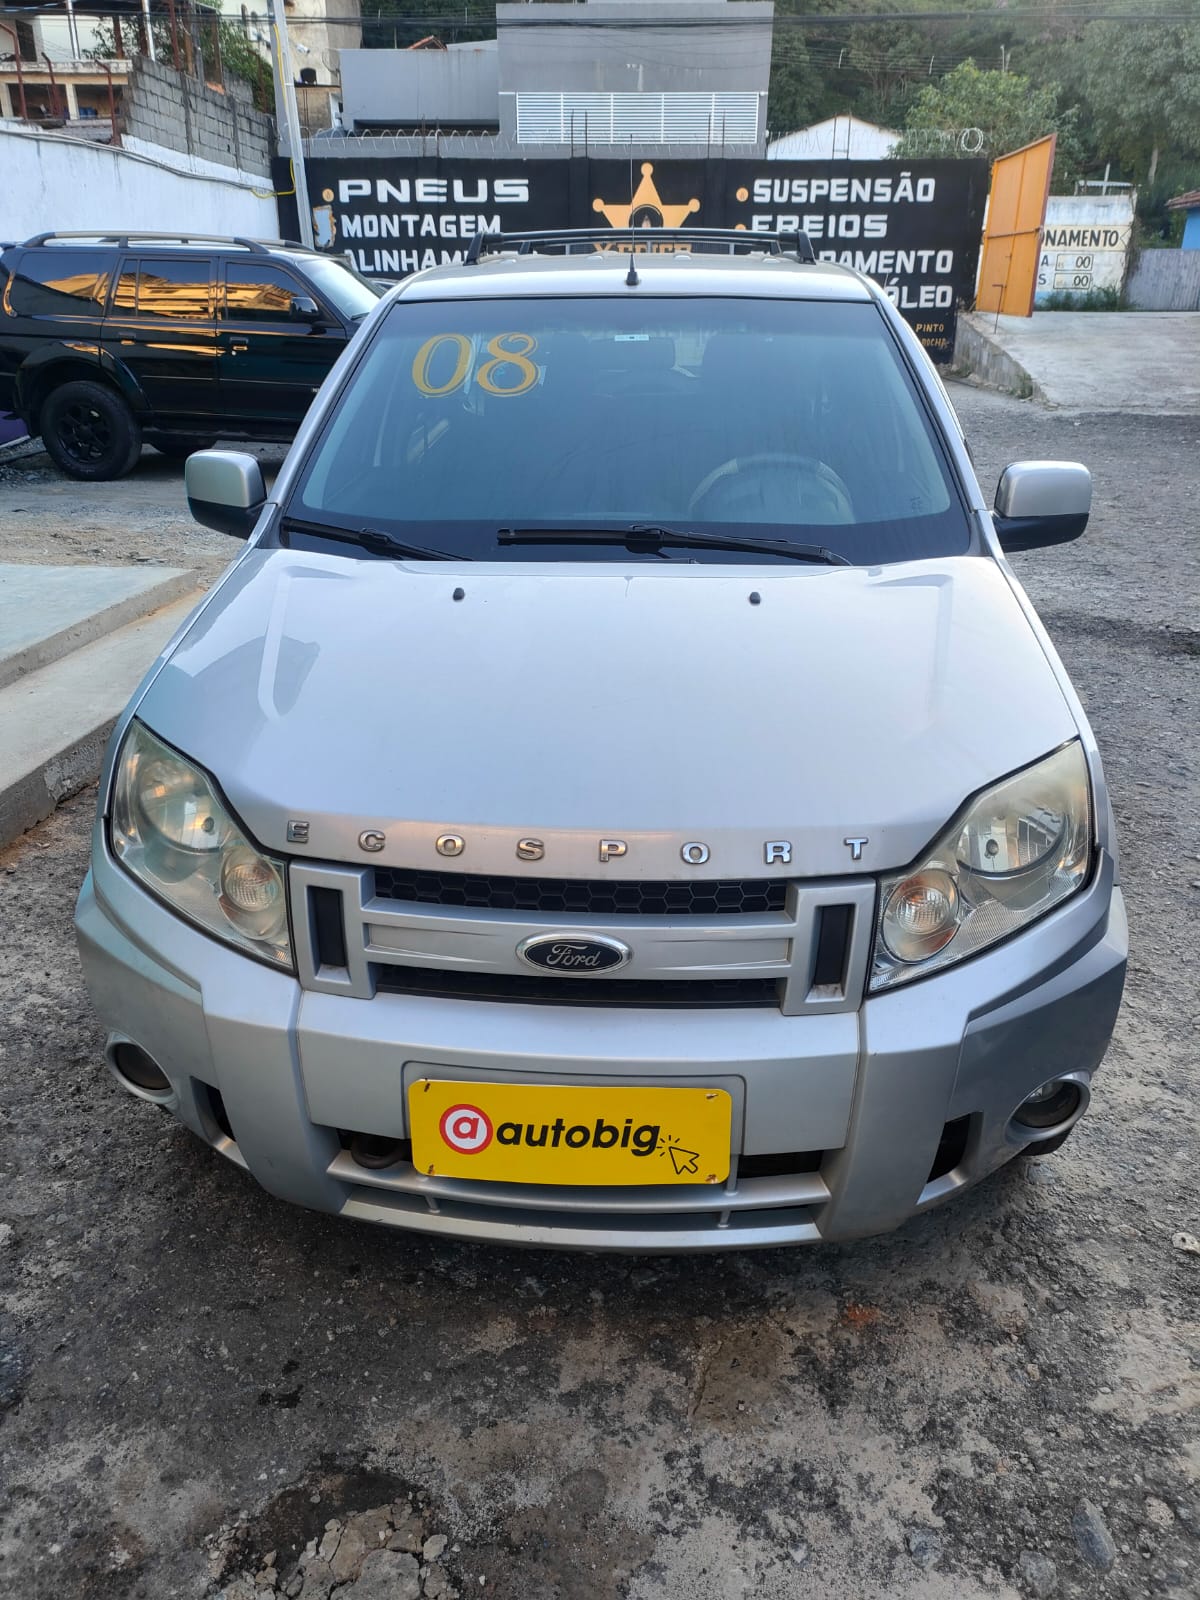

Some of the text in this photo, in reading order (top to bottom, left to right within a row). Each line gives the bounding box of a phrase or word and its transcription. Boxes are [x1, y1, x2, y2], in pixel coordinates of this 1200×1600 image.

[338, 179, 529, 203] PNEUS
[753, 171, 936, 203] SUSPENSÃO
[341, 214, 501, 238] MONTAGEM
[750, 214, 888, 238] FREIOS
[885, 277, 953, 309] ÓLEO
[412, 332, 541, 398] 08
[287, 820, 868, 865] ECOSPORT
[546, 944, 601, 966] Ford
[496, 1119, 660, 1157] autobig
